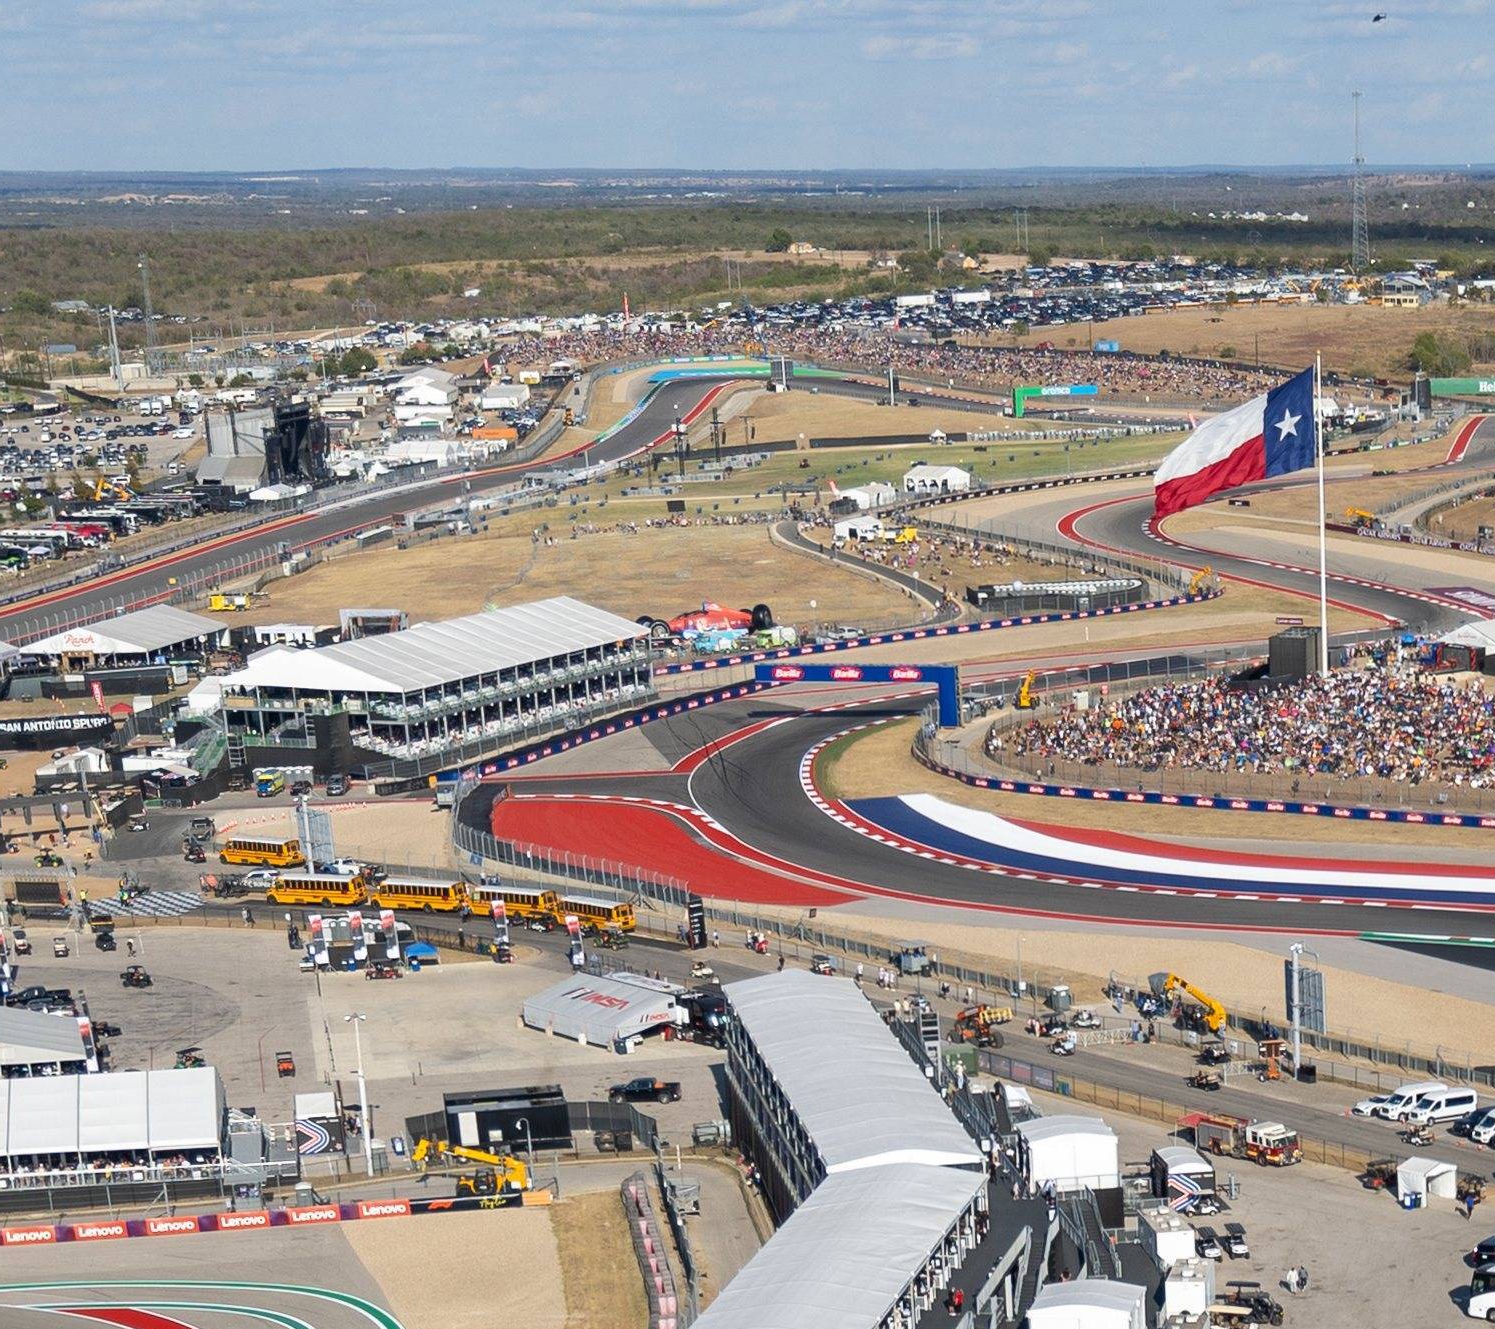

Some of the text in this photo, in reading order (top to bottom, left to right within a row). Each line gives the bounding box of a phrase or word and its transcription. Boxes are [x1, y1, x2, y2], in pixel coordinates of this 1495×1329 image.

[774, 669, 802, 679] Barilla
[833, 669, 861, 679] Barilla
[893, 669, 920, 679] Barilla
[0, 722, 22, 733] SAN
[23, 719, 72, 732] ANTONIO
[291, 1208, 337, 1223] Lenovo
[362, 1203, 407, 1217] Lenovo
[149, 1219, 196, 1233] Lenovo
[220, 1214, 266, 1228] Lenovo
[4, 1229, 53, 1244] Lenovo
